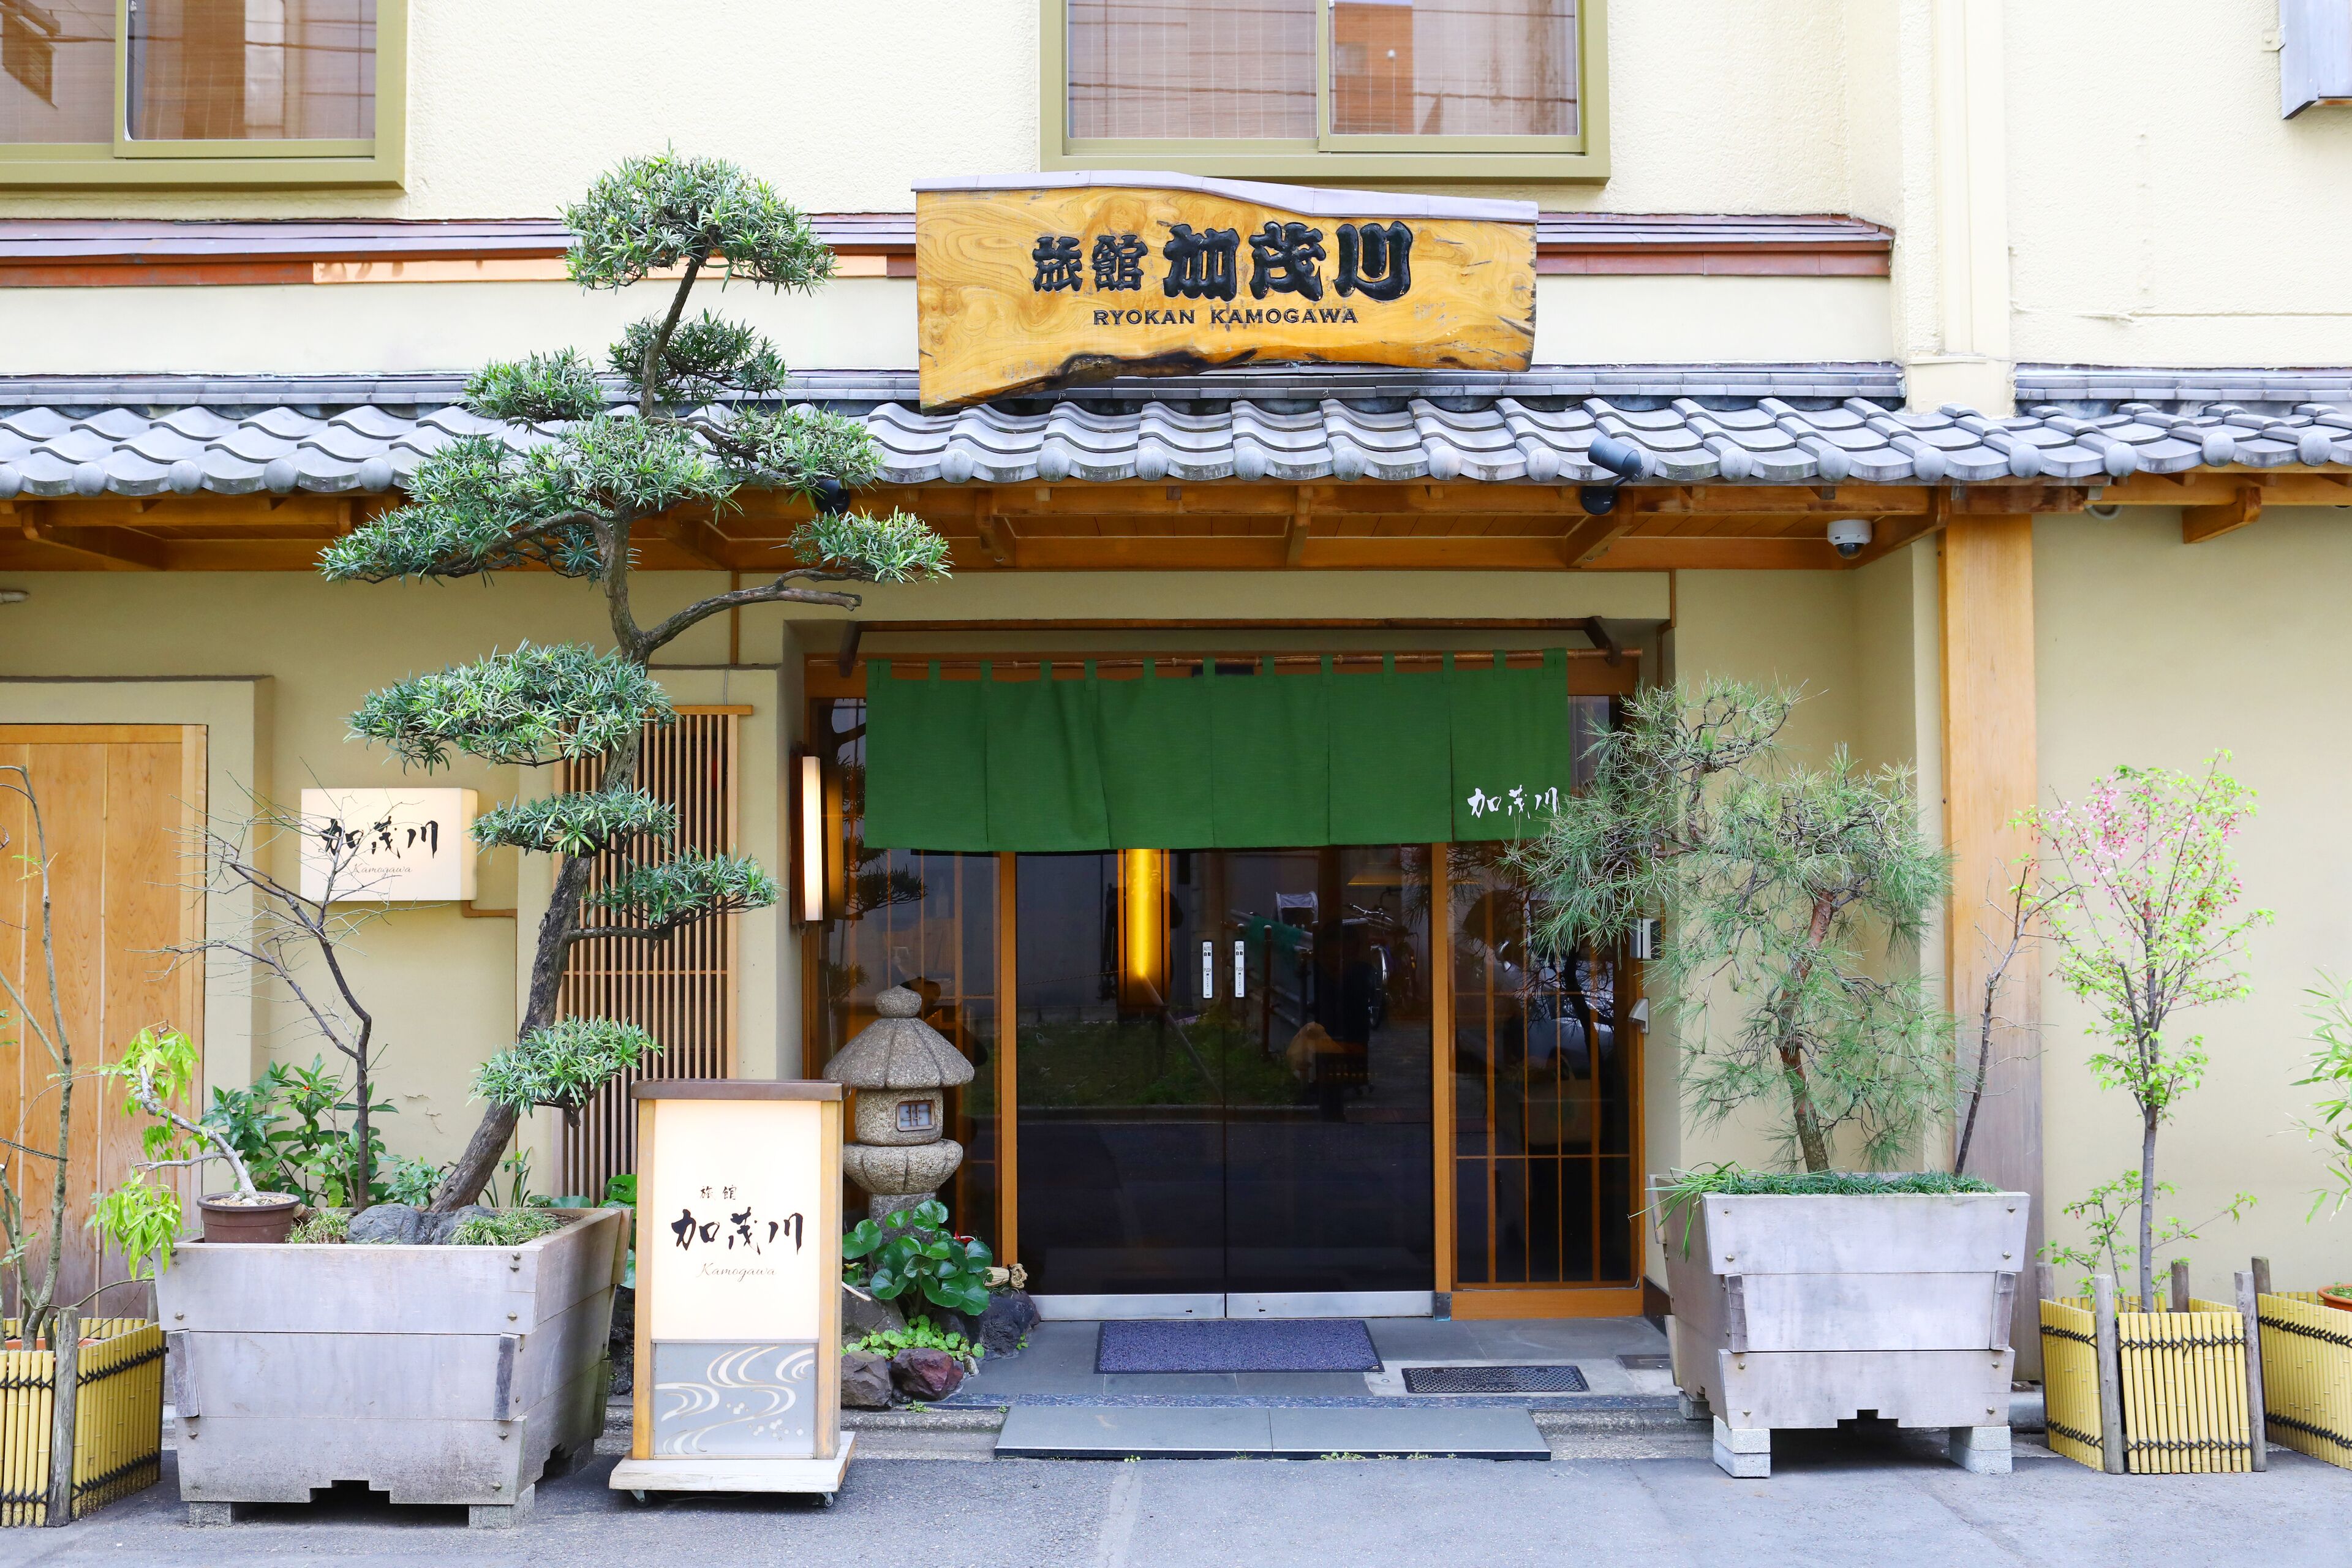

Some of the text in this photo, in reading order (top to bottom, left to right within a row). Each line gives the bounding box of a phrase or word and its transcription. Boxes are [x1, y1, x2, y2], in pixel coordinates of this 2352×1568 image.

[1031, 220, 1414, 303] 旅館 加茂川
[1093, 308, 1359, 325] RYOKAN KAMOGAWA
[1466, 784, 1558, 820] 加茂川
[320, 815, 439, 859] 加茂川
[350, 862, 413, 880] Kamogawa
[699, 1185, 737, 1201] 旅館
[671, 1206, 804, 1256] 加茂川
[696, 1262, 775, 1283] Kamogawa
